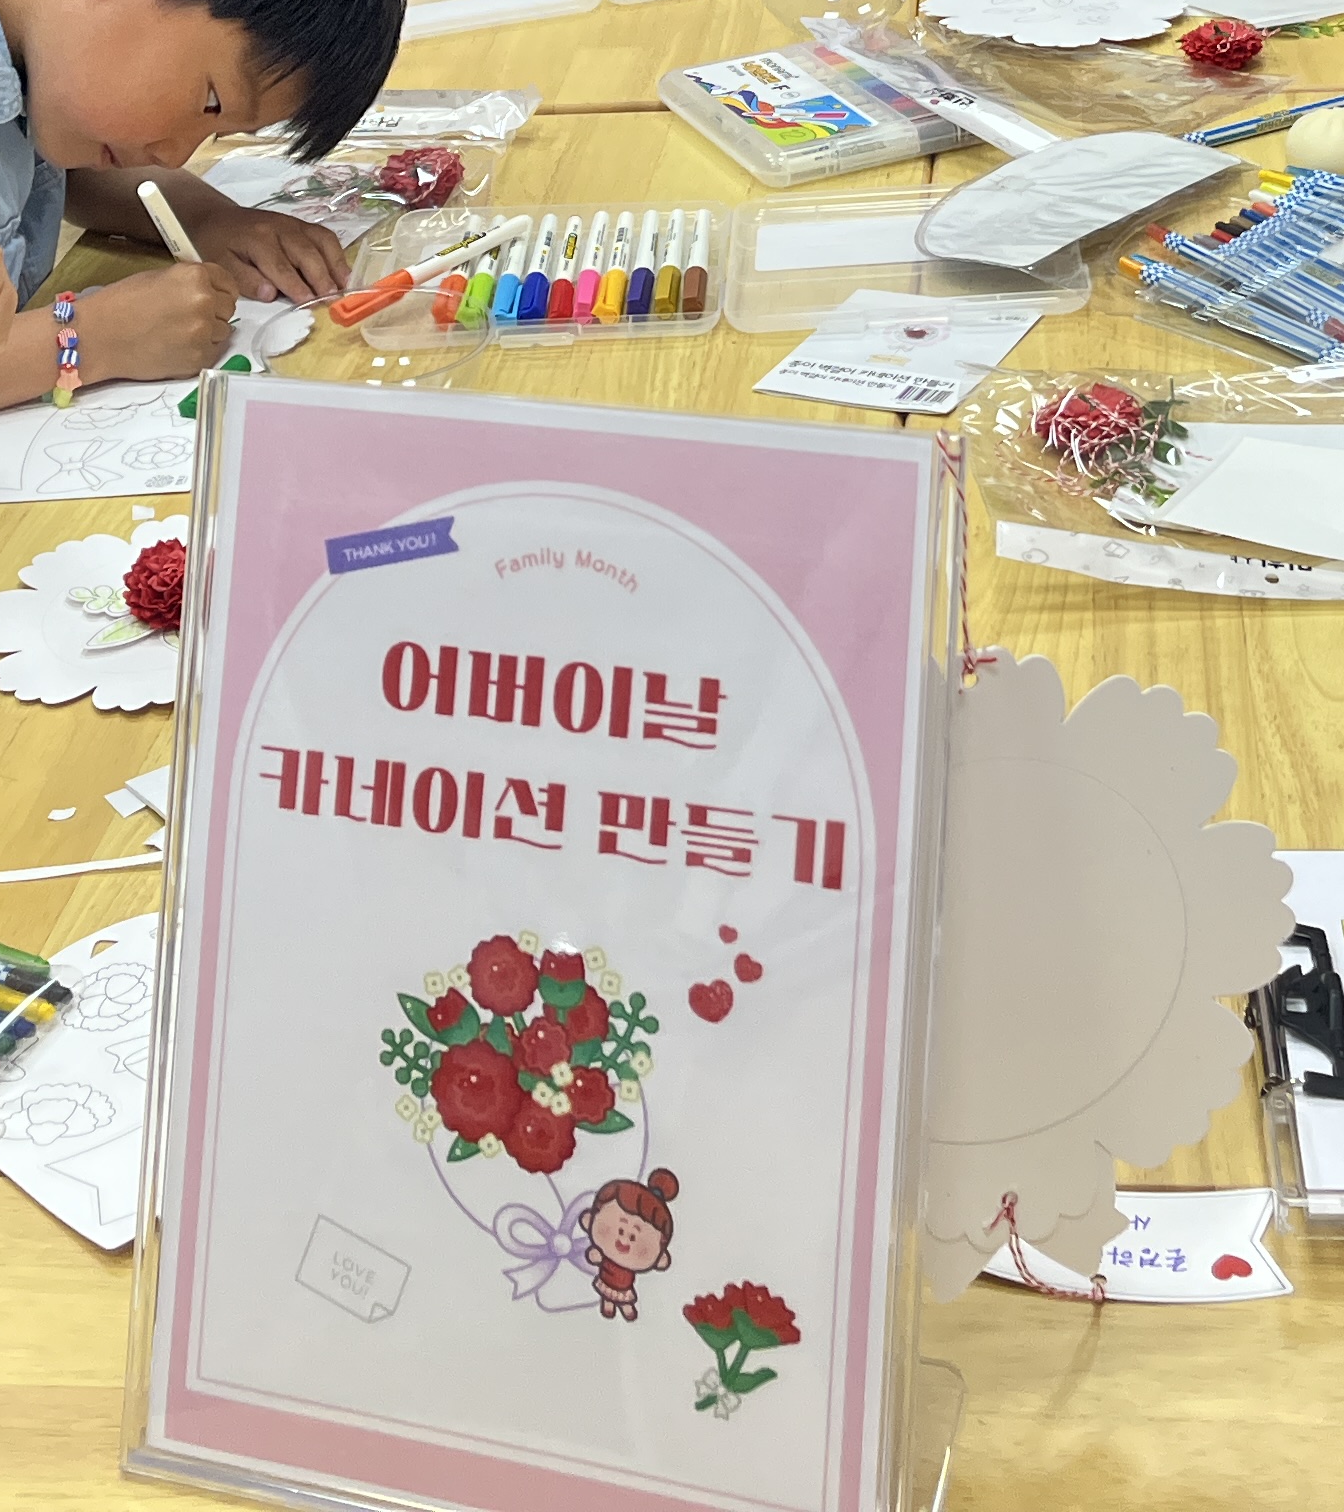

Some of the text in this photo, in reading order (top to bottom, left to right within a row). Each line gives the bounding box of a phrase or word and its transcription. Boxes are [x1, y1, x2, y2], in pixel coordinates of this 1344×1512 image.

[342, 532, 438, 562] THANK YOU!
[494, 547, 640, 593] Family Month
[382, 640, 728, 750] 어버이날
[259, 745, 847, 891] 카네이션 만들기
[332, 1250, 377, 1286] LOVE
[1106, 1245, 1188, 1274] 존경하
